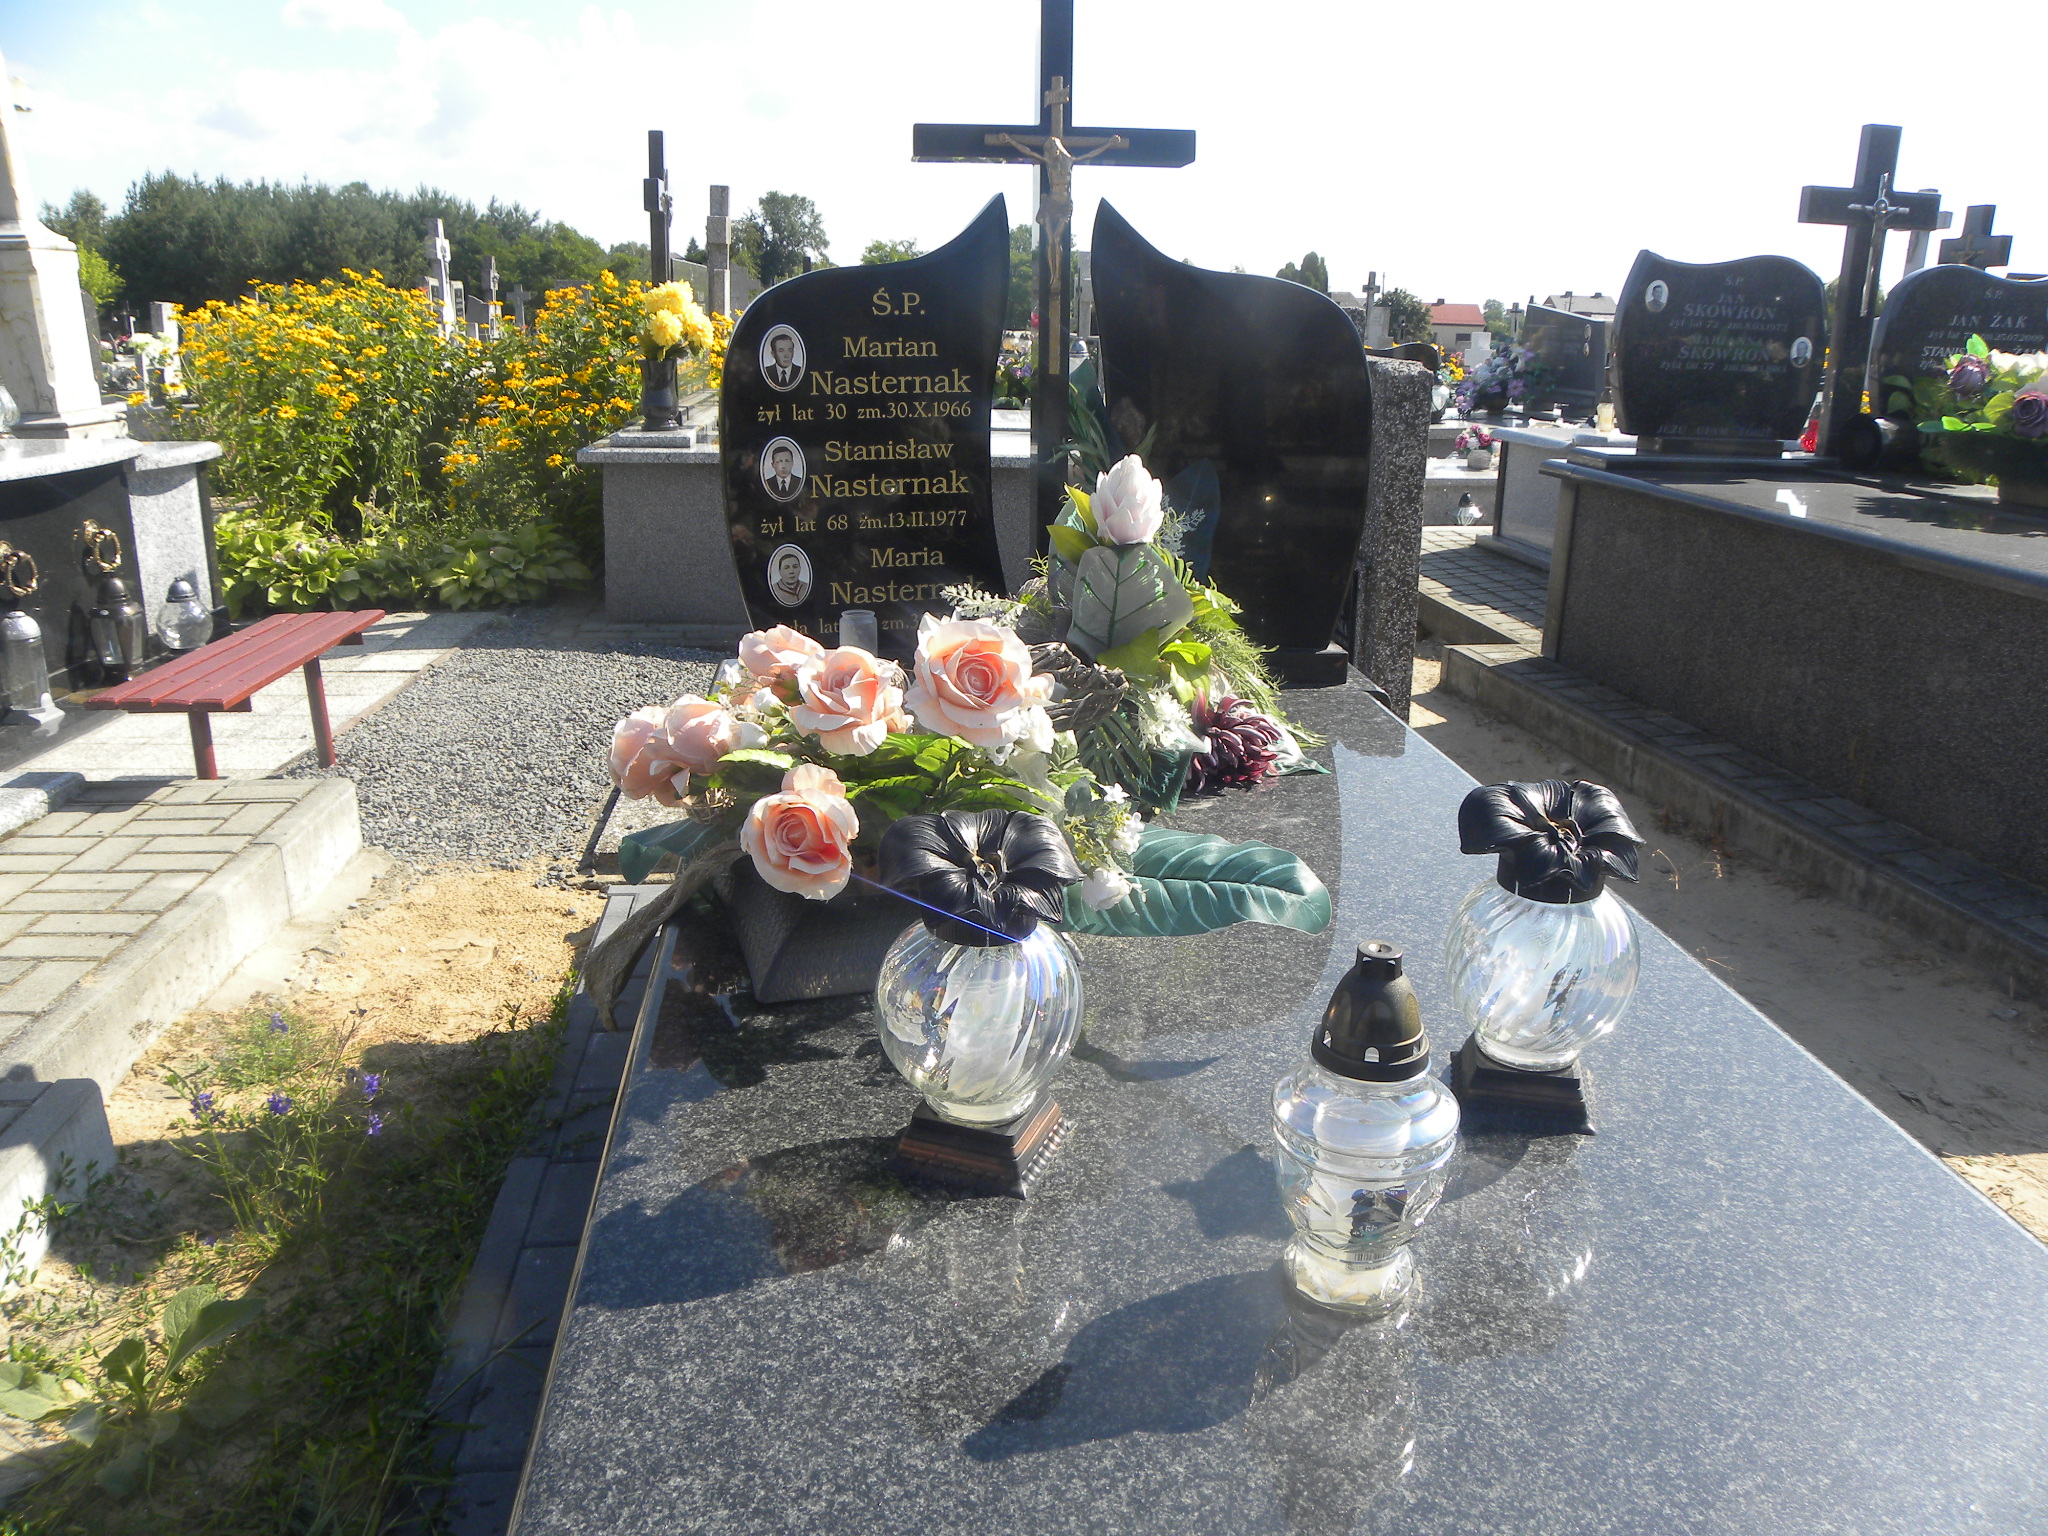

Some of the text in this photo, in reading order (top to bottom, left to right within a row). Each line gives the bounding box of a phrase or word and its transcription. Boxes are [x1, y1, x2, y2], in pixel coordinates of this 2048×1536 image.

[872, 287, 926, 316] Ś.P.
[1683, 303, 1777, 320] SKOWRON
[1950, 312, 2028, 328] JAN ŻAK
[843, 336, 938, 358] Marian
[810, 368, 971, 396] Nasternak
[757, 400, 971, 425] żył lat 30 zm.30.X.1966
[824, 438, 954, 462] Stanisław
[810, 470, 969, 498] Nasternak
[760, 510, 967, 536] żył lat 68 zm.13.II.1977
[870, 546, 944, 568] Maria
[830, 575, 984, 606] Nasternk
[819, 618, 840, 634] lat
